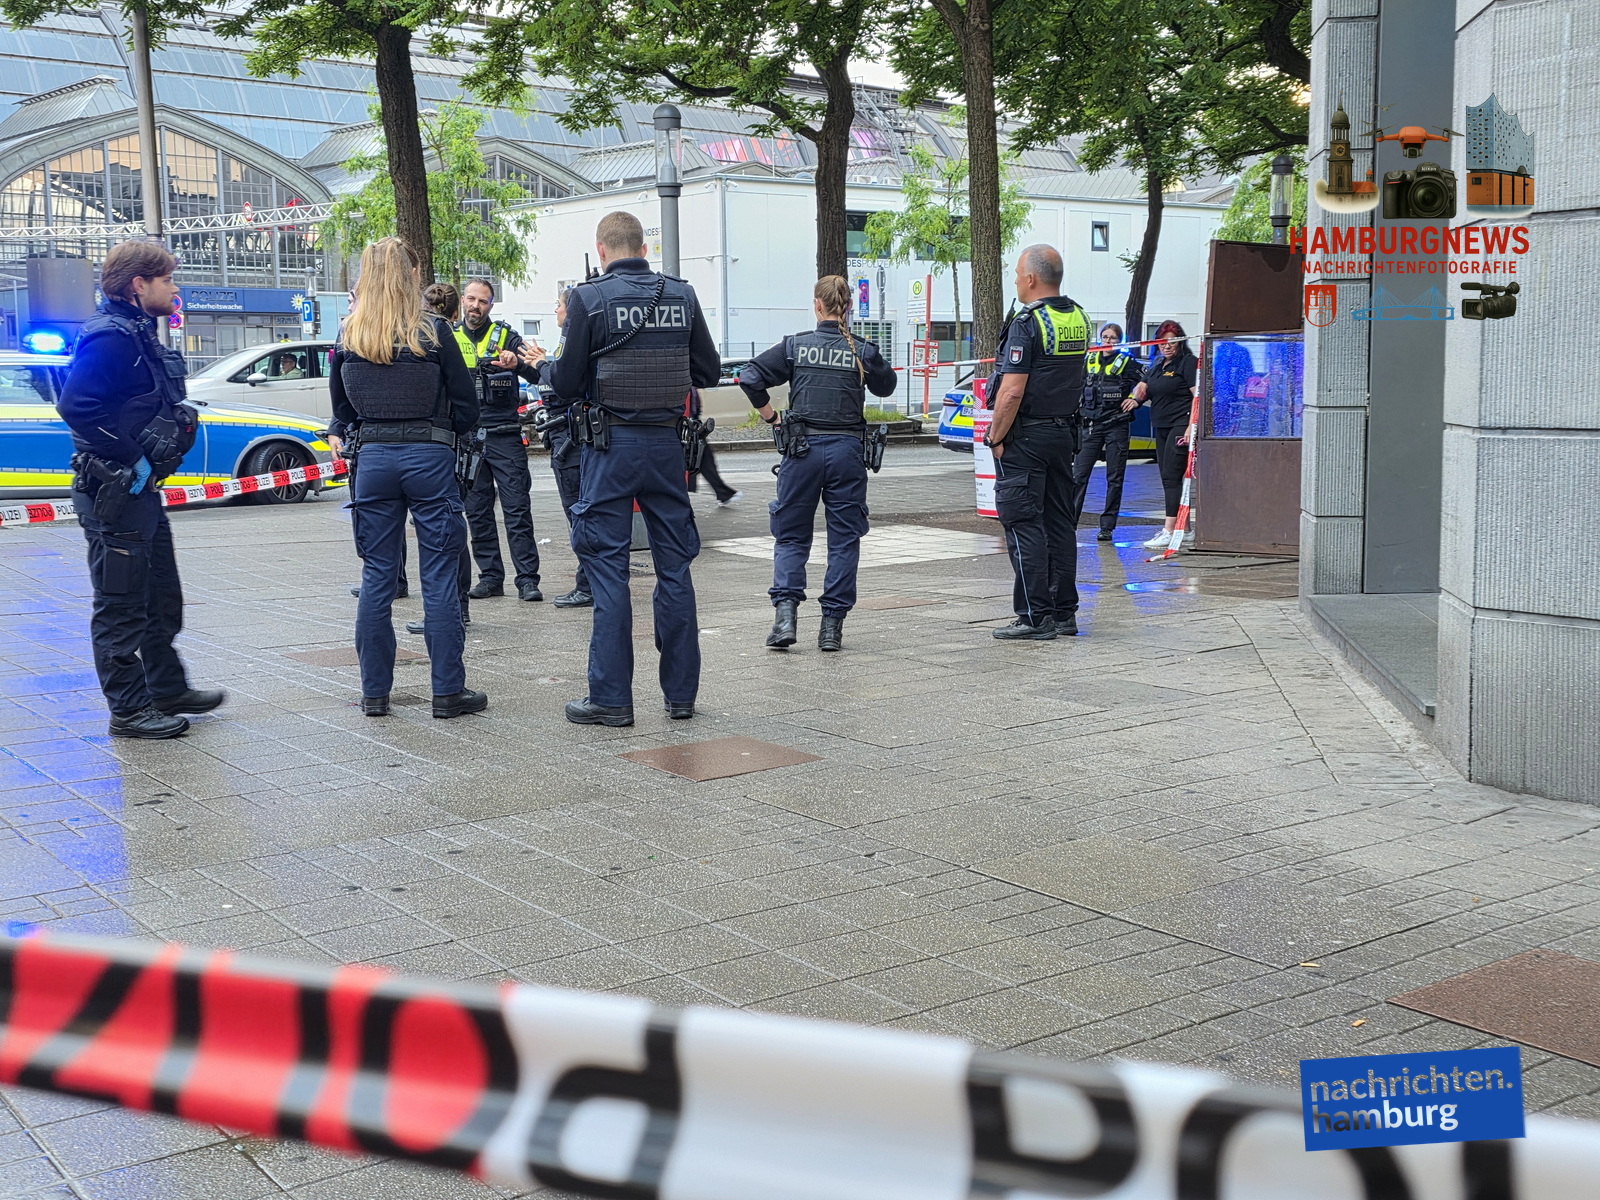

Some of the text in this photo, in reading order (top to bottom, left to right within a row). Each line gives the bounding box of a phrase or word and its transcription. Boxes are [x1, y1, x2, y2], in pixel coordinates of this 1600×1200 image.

[191, 290, 237, 302] POLIZEI
[187, 302, 242, 310] Sicherheitswache
[304, 305, 311, 319] P
[616, 305, 687, 328] POLIZEI
[1058, 326, 1085, 339] POLIZEI
[797, 346, 856, 368] POLIZEI
[165, 490, 185, 502] POLIZEI
[210, 484, 230, 495] POLIZEI
[291, 469, 307, 480] POLIZEI
[56, 504, 77, 516] POLIZ
